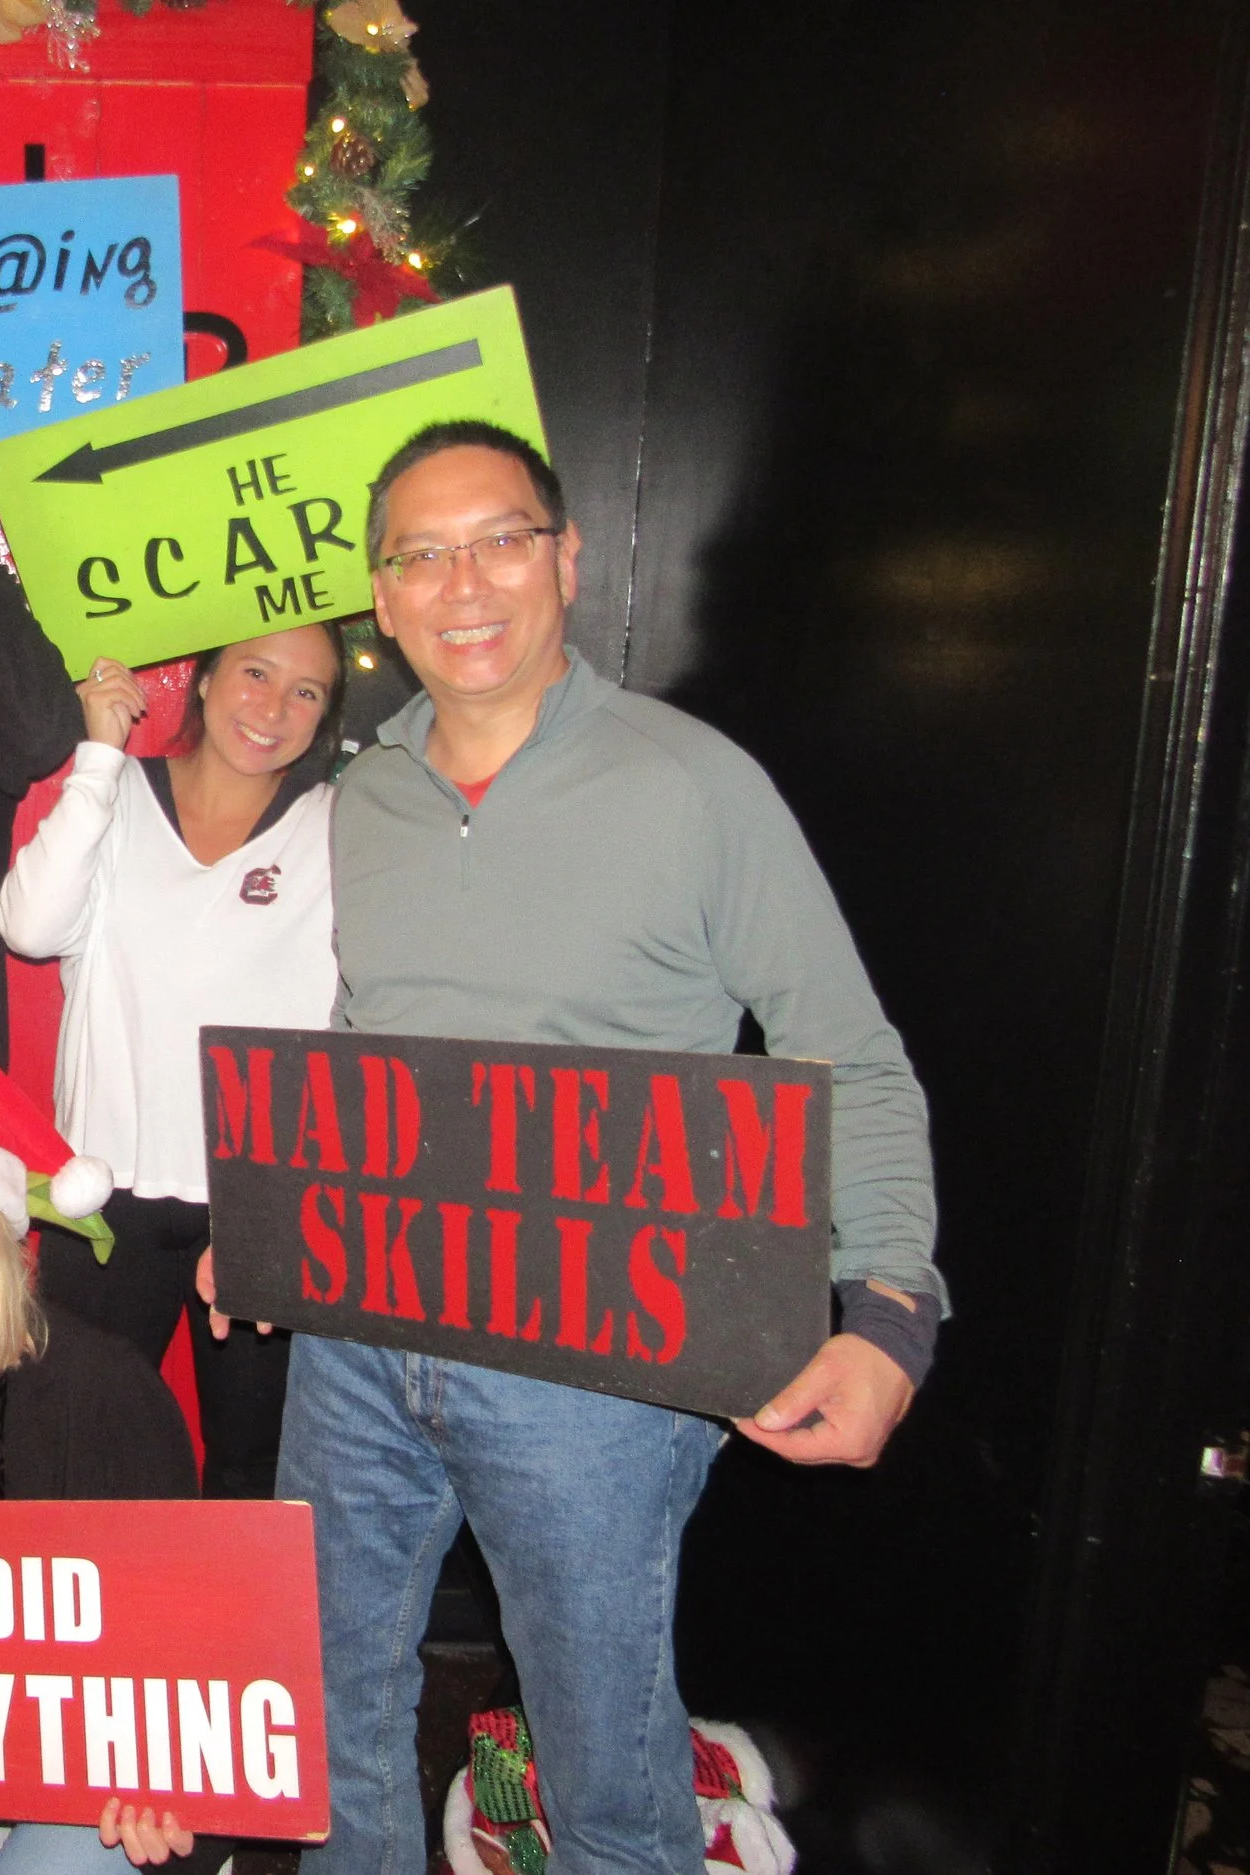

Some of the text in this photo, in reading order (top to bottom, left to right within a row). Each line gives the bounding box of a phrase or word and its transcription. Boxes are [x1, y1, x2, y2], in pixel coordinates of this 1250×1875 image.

[76, 480, 378, 620] SCAR
[226, 453, 297, 507] HE
[255, 571, 335, 624] ME
[208, 1046, 813, 1229] MAD TEAM
[299, 1182, 688, 1366] SKILLS
